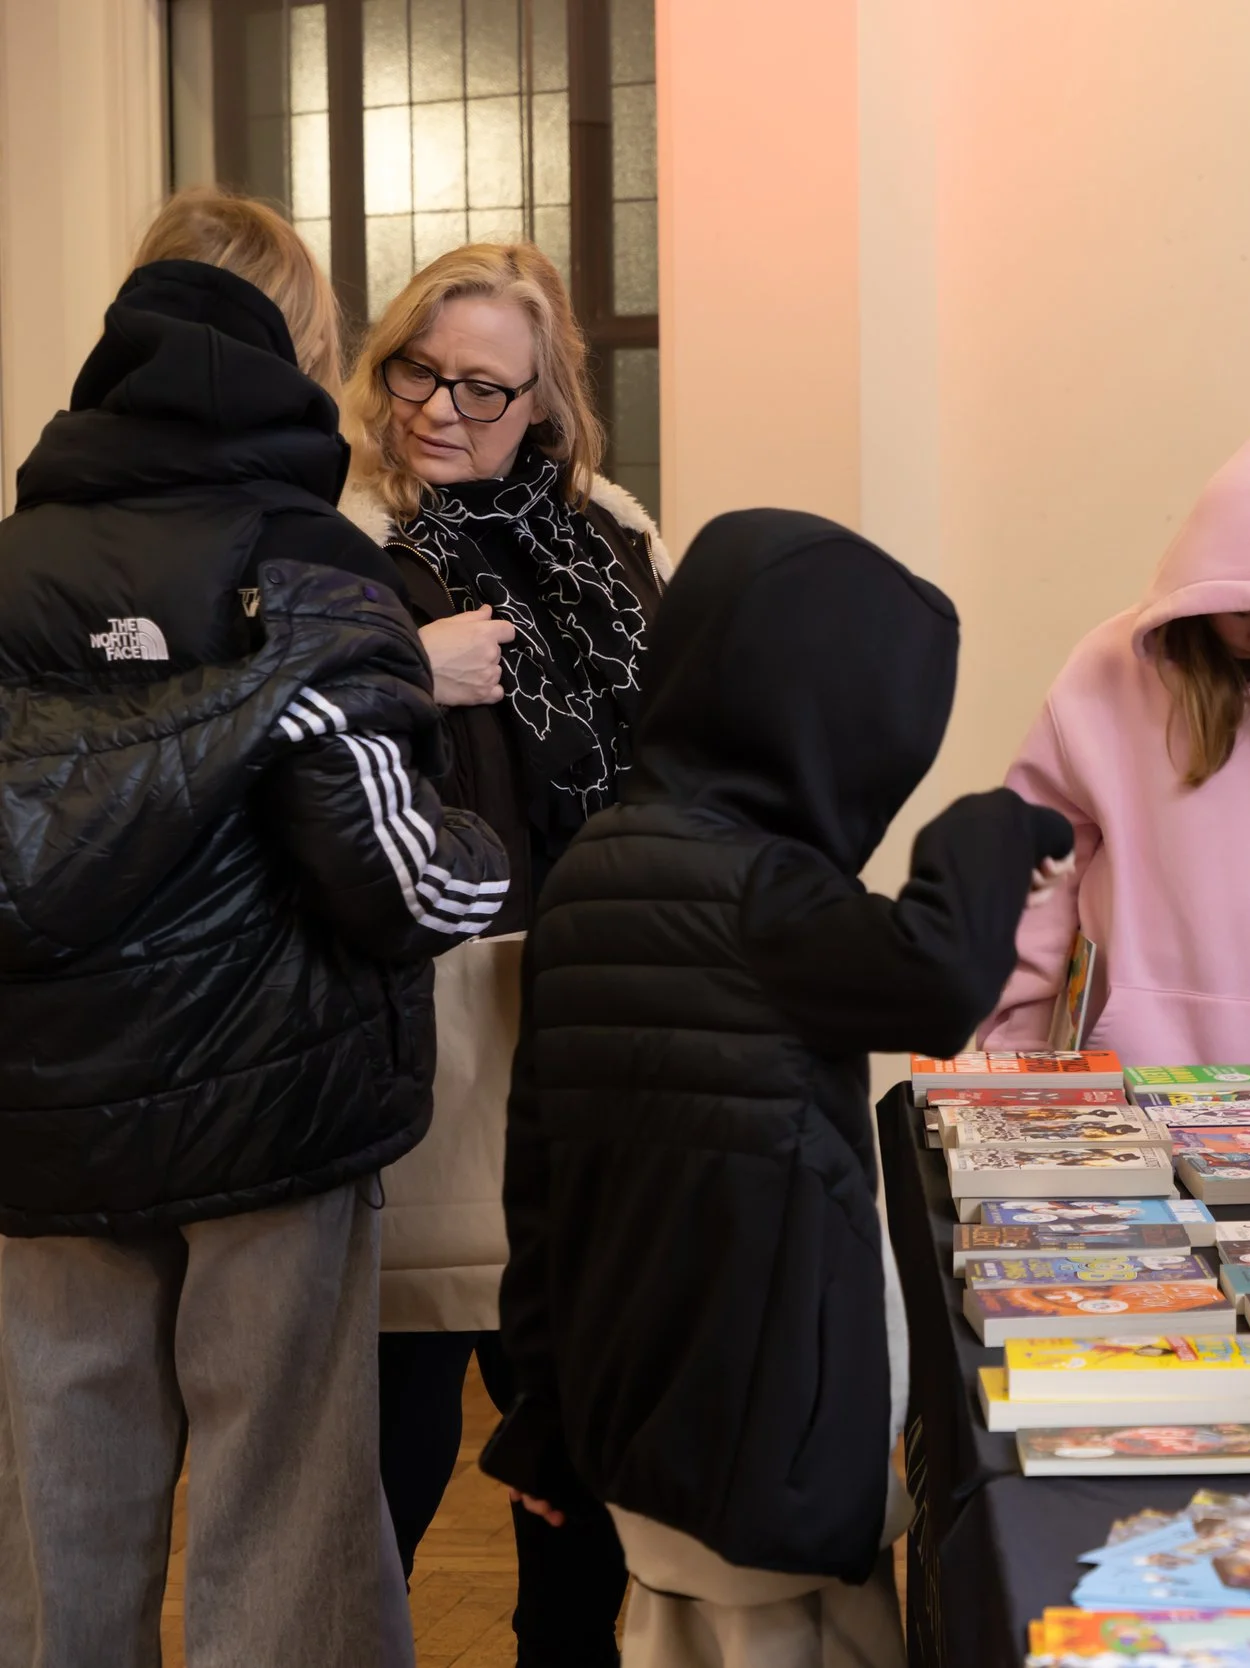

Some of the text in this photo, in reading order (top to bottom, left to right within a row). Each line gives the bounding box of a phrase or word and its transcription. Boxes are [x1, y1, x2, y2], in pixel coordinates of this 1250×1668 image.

[108, 618, 137, 632] THE
[90, 632, 139, 648] NORTH
[105, 647, 141, 661] FACE
